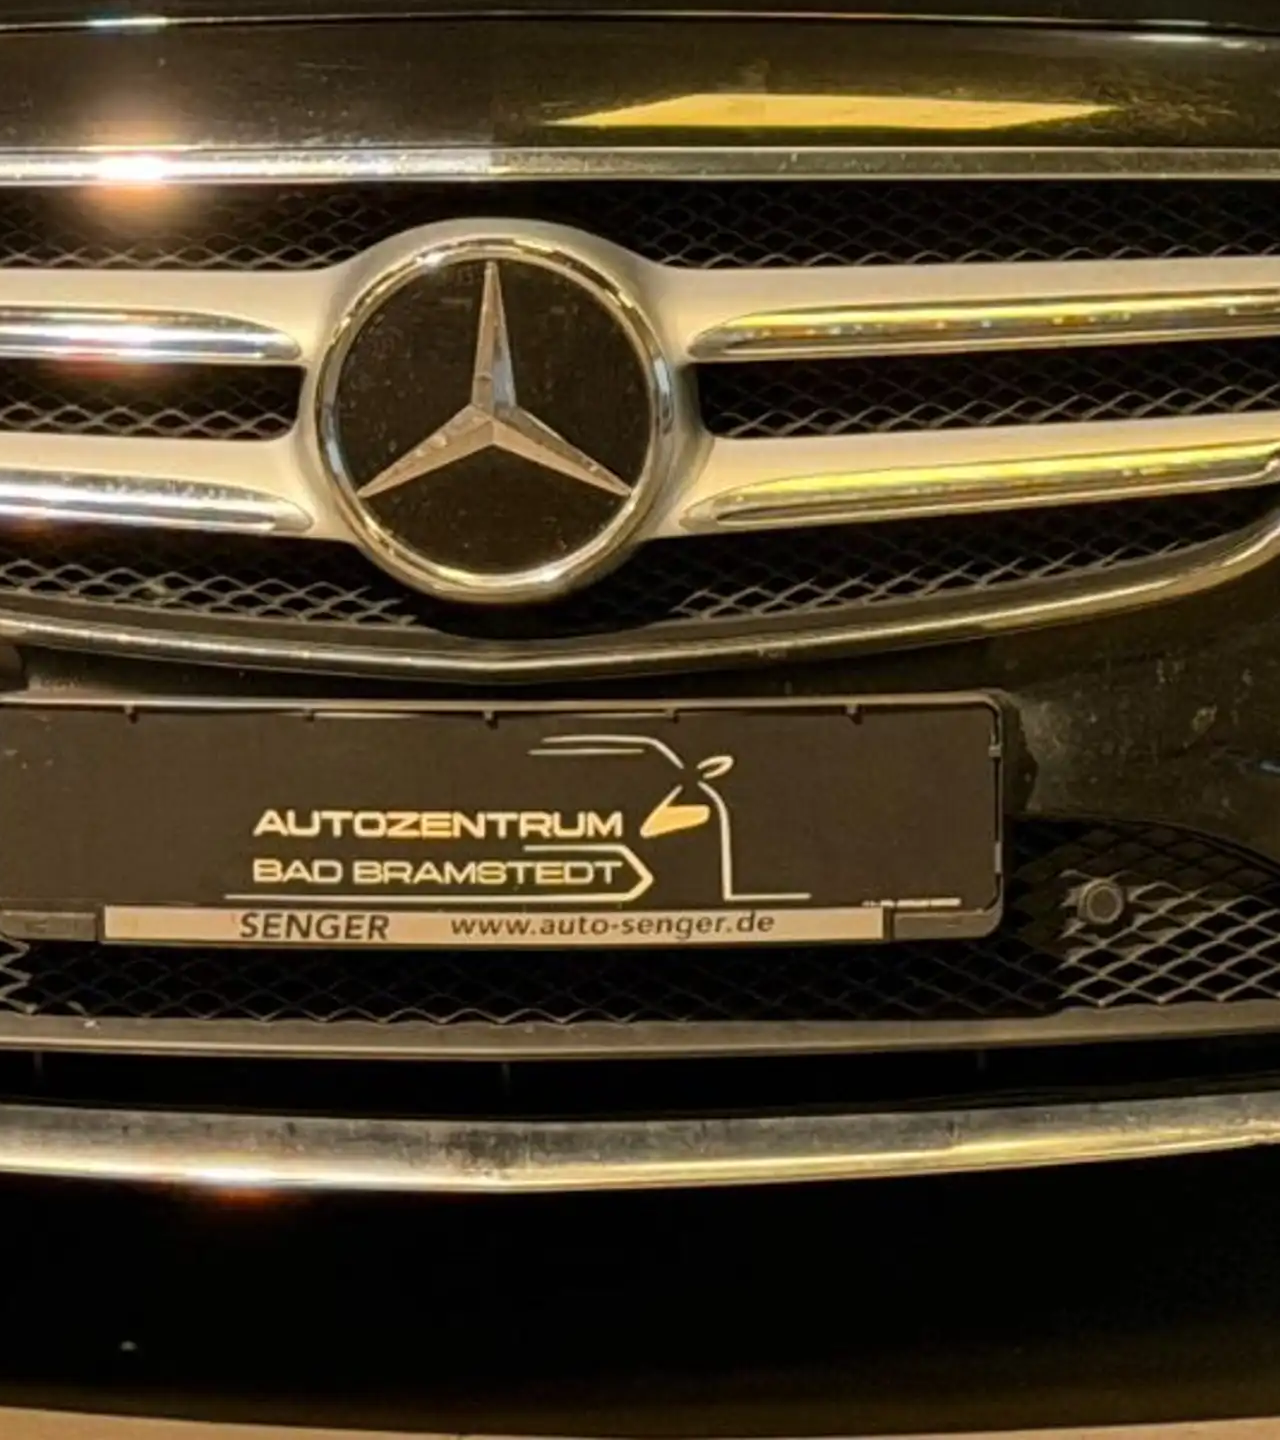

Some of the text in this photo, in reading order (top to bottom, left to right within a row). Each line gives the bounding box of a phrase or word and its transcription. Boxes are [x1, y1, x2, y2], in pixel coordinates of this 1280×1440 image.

[252, 809, 623, 838] AUTOZENTRUM
[252, 858, 623, 886] BAD BRAMSTEDT
[240, 912, 390, 940] SENGER
[451, 910, 776, 940] www.auto-senger.de
